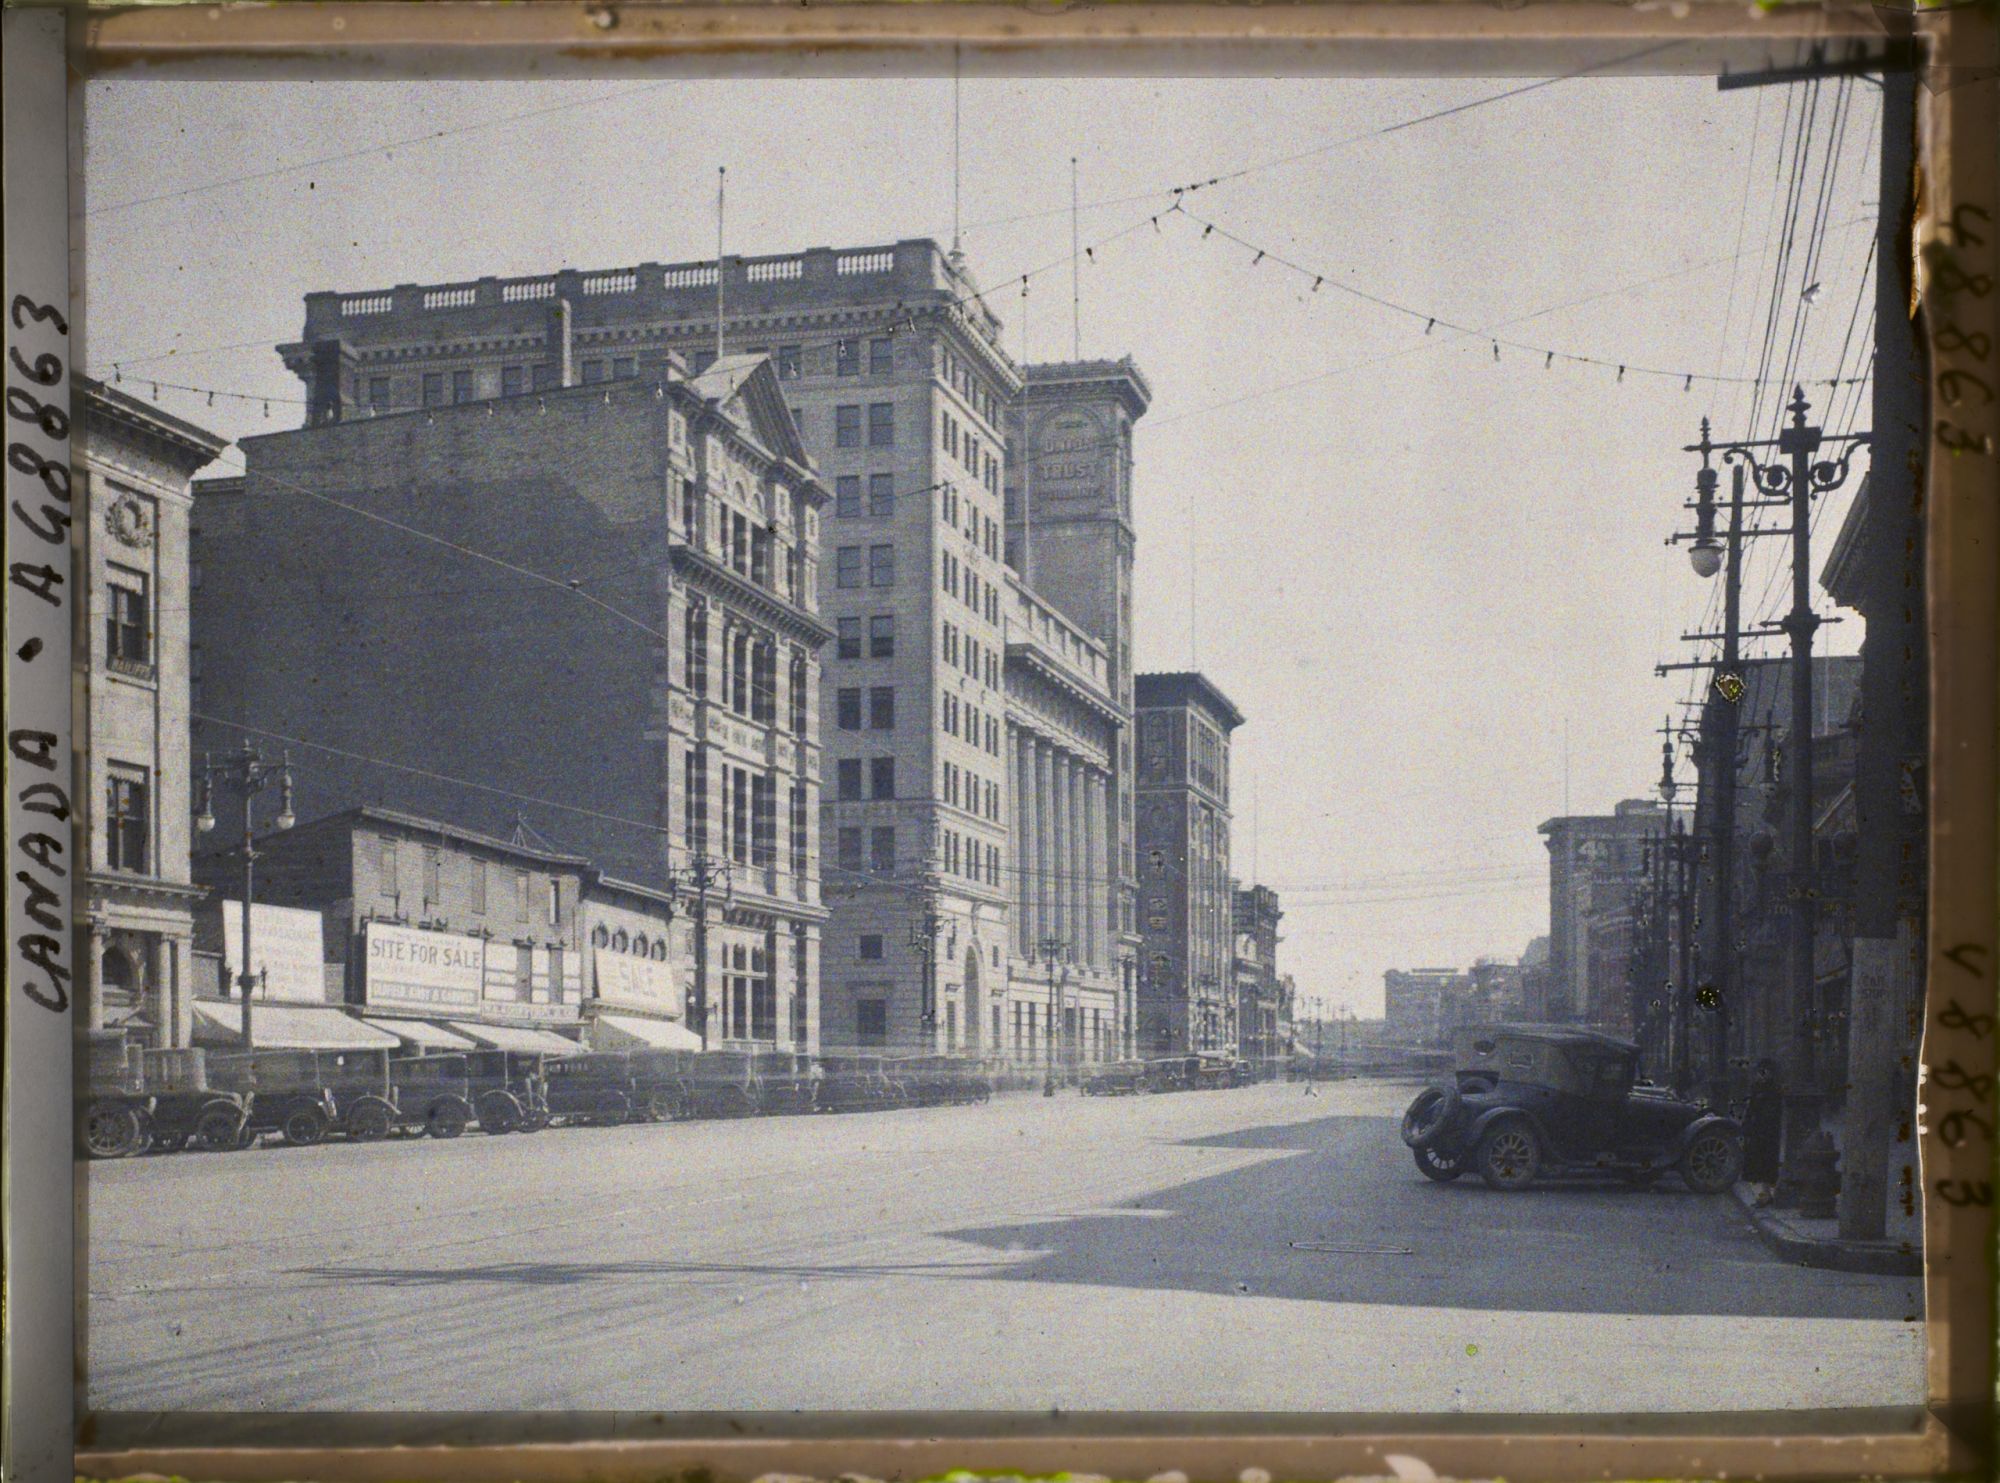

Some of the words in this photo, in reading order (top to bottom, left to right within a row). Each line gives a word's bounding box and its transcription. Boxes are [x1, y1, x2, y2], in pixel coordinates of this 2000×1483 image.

[10, 727, 70, 1012] CANADA
[370, 938, 405, 961] SITE
[410, 943, 438, 965] FOR
[443, 948, 480, 970] SALE
